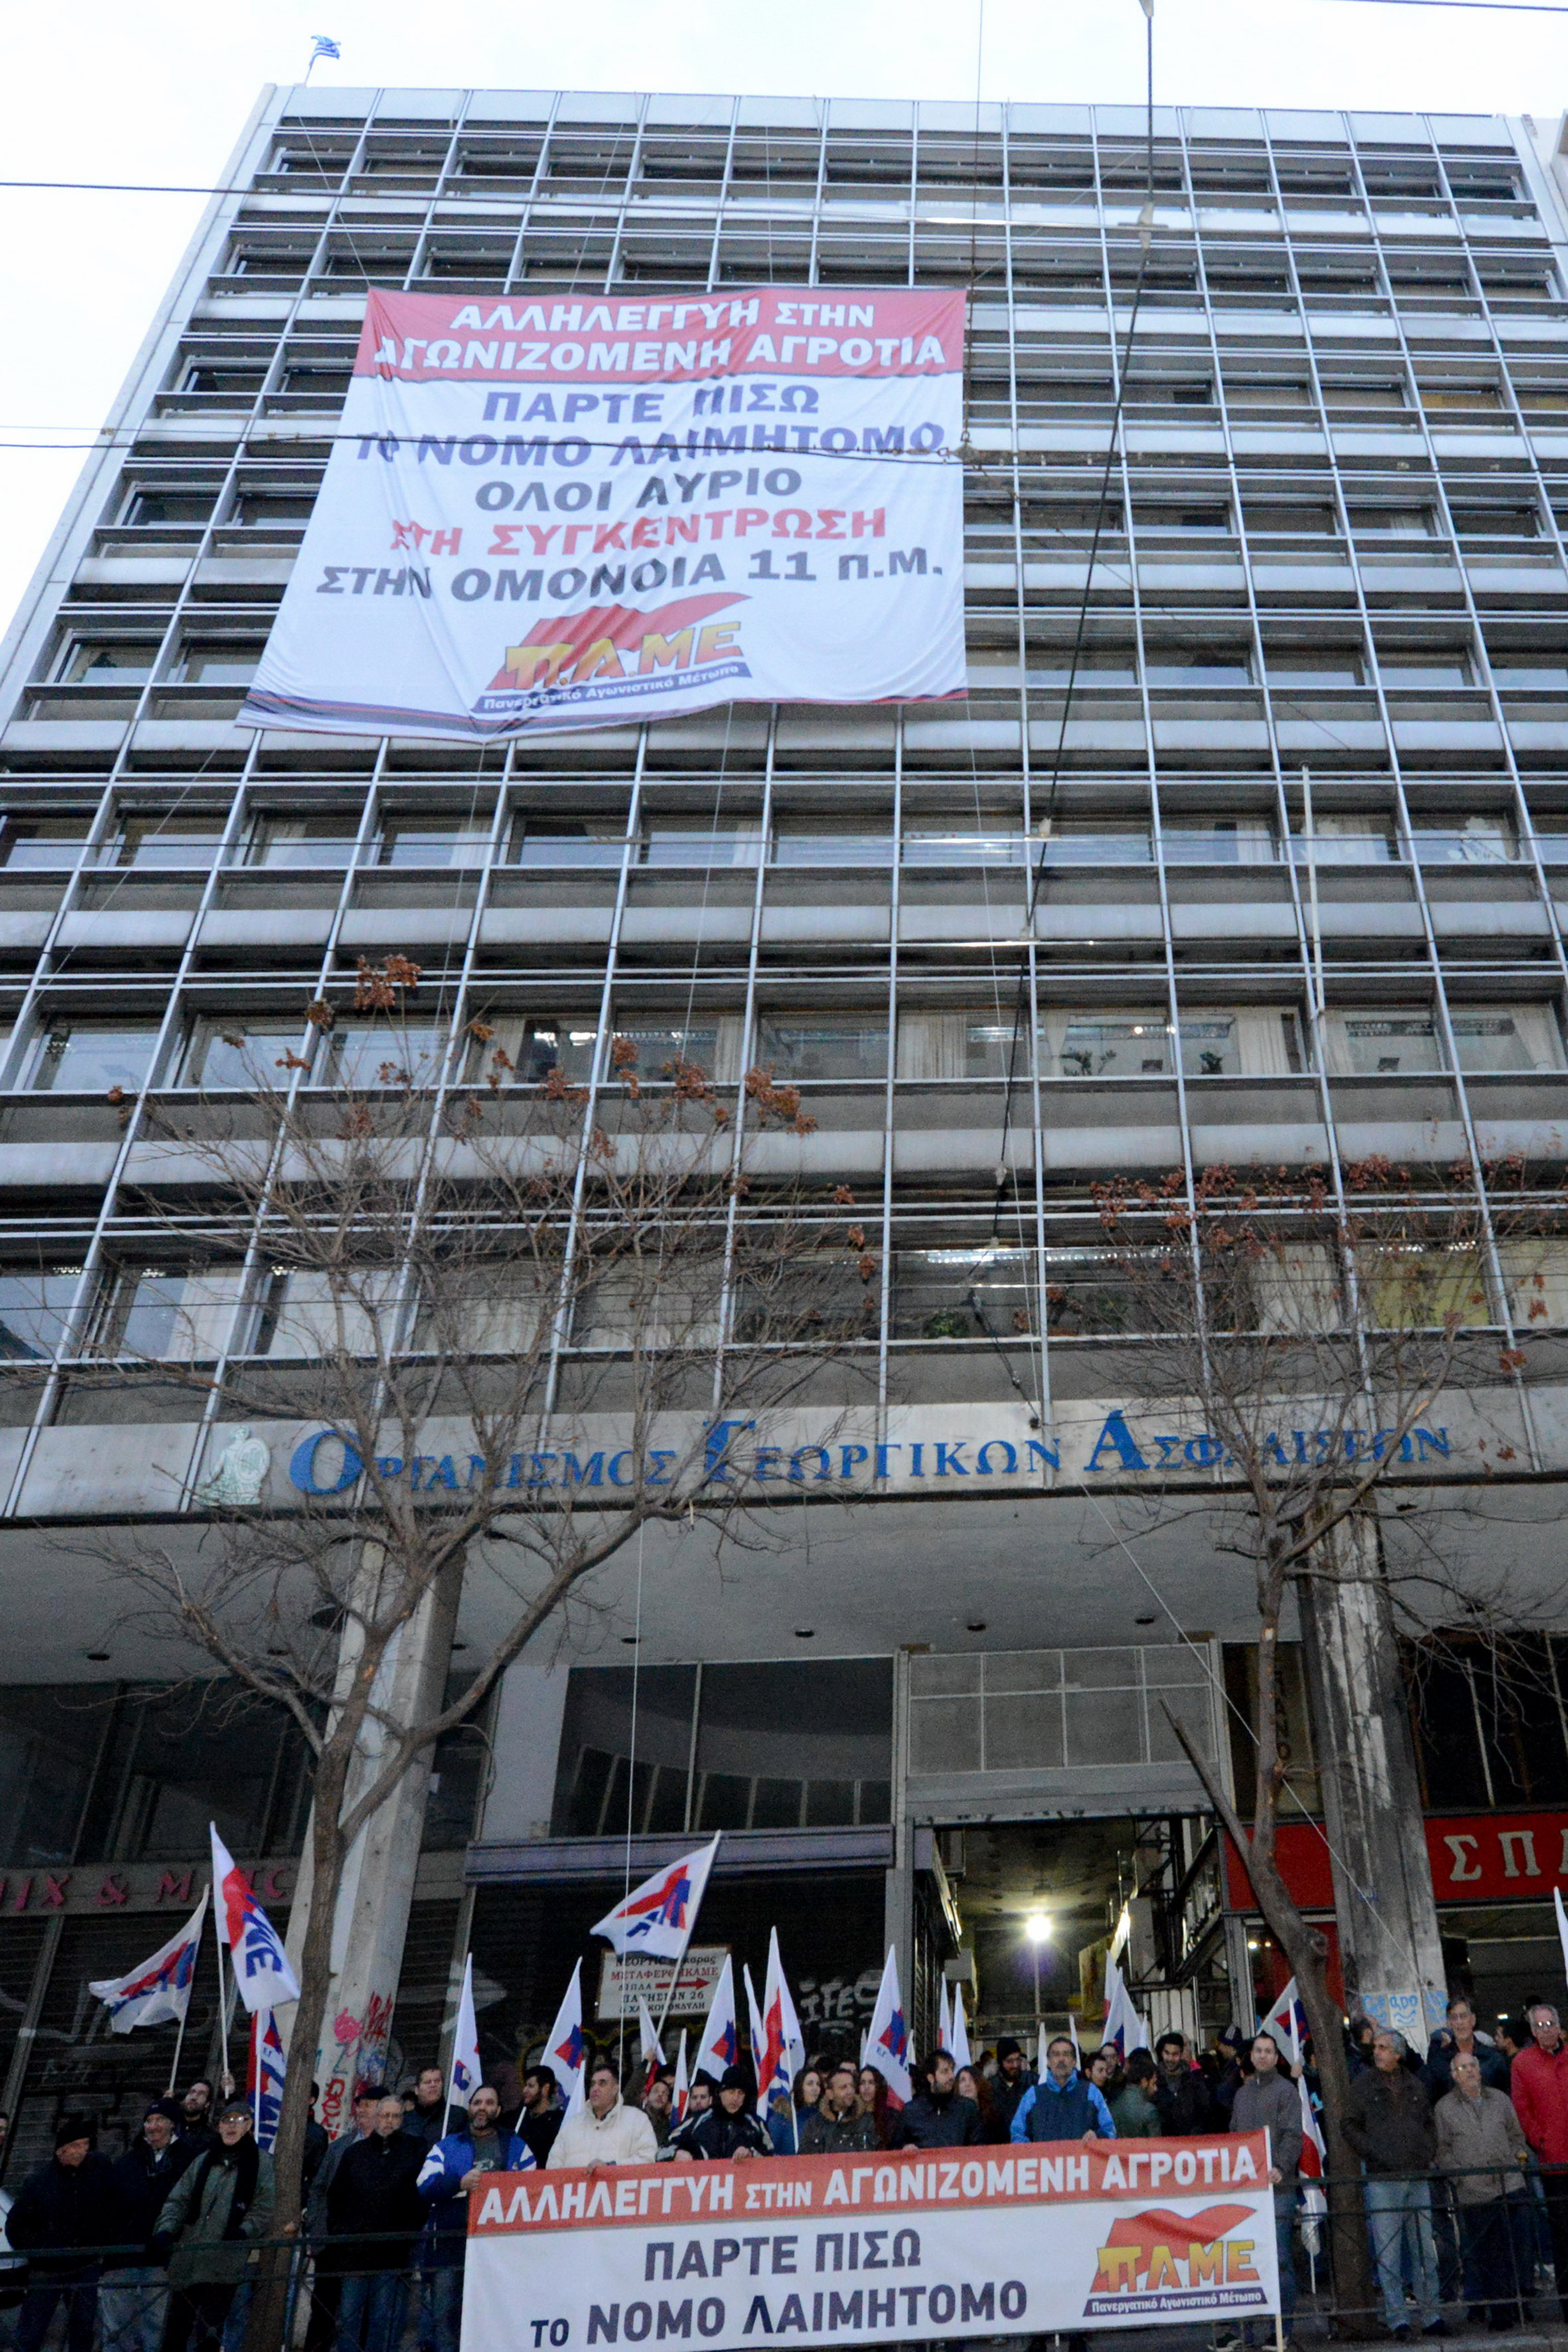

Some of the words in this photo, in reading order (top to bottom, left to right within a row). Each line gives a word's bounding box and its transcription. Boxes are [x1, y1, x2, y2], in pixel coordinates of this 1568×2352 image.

[450, 297, 760, 331] ΑΛΛΗΛΕΓΓΥΗ
[775, 301, 874, 328] ΣΤΗΝ
[374, 335, 731, 371] ΑΓΩΝΙΖΟΜΕΝΗ
[745, 333, 946, 366] ΑΓΡΟΤΙΑ
[482, 391, 665, 424] ΠΑΡΤΕ
[693, 383, 819, 417] ΠΙΣΩ
[356, 430, 400, 463] ΤΟ
[418, 433, 592, 467] ΝΟΜΟ
[609, 422, 945, 467] ΛΑΙΜΗΤΟΜΟ
[475, 481, 612, 512] ΟΛΟΙ
[635, 467, 802, 508] ΑΥΡΙΟ
[390, 519, 463, 555] ΣΤΗ
[487, 507, 885, 556] ΣΥΓΚΕΝΤΡΩΣΗ
[316, 566, 431, 598] ΣΤΗΝ
[451, 552, 726, 601] ΟΜΟΝΟΙΑ
[747, 549, 817, 581] 11
[838, 546, 943, 581] Π.Μ.
[586, 677, 673, 701] Αγωνιστικό
[678, 665, 739, 686] Μέτωπο
[702, 1420, 1061, 1482] ΓΕΩΡΓΙΚΩΝ
[1083, 1409, 1451, 1471] ΑΣΦΛΙΣΕΩΝ
[95, 1873, 129, 1907] &
[690, 1991, 704, 2000] 26
[477, 2174, 734, 2225] ΑΛΛΗΛΕΓΓΥΗ
[745, 2181, 812, 2210] ΣΤΗΝ
[824, 2154, 1089, 2205] ΑΓΩΝΙΖΟΜΕΝΗ
[1101, 2146, 1257, 2191] ΑΓΡΟΤΙΑ
[645, 2235, 799, 2282] ΠΑΡΤΕ
[815, 2229, 921, 2272] ΠΙΣΩ
[530, 2318, 569, 2349] ΤΟ
[587, 2297, 726, 2345] ΝΟΜΟ
[742, 2280, 1027, 2334] ΛΑΙΜΗΤΟΜΟ
[1091, 2296, 1158, 2314] Πανεργατικό
[1160, 2292, 1217, 2310] Αγωνιστικό
[1219, 2290, 1262, 2304] Μέτωπο
